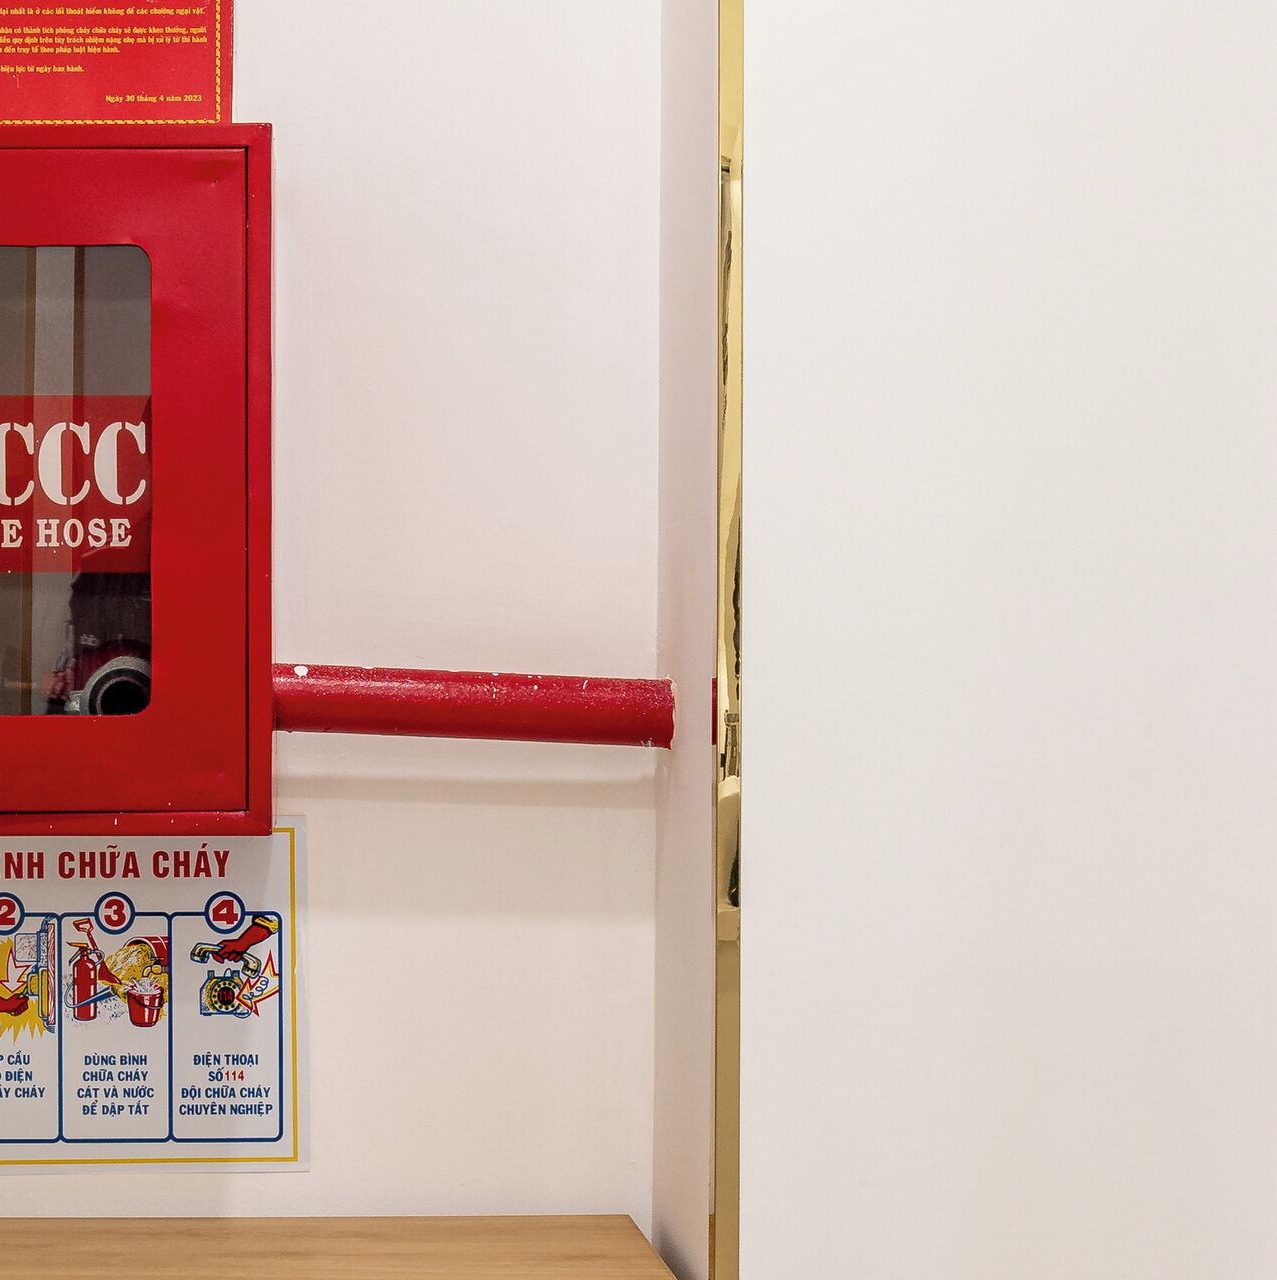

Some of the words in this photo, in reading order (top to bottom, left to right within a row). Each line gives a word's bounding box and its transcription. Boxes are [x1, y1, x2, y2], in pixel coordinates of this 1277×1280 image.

[36, 518, 132, 549] HOSE
[58, 844, 141, 880] CHỮA
[152, 842, 230, 879] CHÁY
[103, 899, 126, 927] 3
[212, 899, 239, 925] 4
[7, 1050, 30, 1065] CẦU
[84, 1052, 116, 1066] DÙNG
[120, 1052, 147, 1065] BÌNH
[193, 1051, 221, 1067] ĐIỆN
[224, 1054, 258, 1067] THOẠI
[5, 1068, 33, 1083] ĐIỆN
[82, 1069, 114, 1082] CHỮA
[117, 1068, 148, 1081] CHÁY
[14, 1084, 45, 1098] CHÁY
[77, 1085, 100, 1098] CÁT
[103, 1085, 119, 1098] VÀ
[123, 1085, 154, 1098] NƯỚC
[181, 1085, 201, 1101] ĐỘI
[205, 1085, 236, 1098] CHỮA
[240, 1084, 270, 1098] CHÁY
[82, 1099, 98, 1115] ĐỂ
[102, 1102, 125, 1117] DẬP
[128, 1100, 149, 1115] TẮT
[179, 1099, 226, 1115] CHUYÊN
[230, 1101, 273, 1117] NGHIỆP
